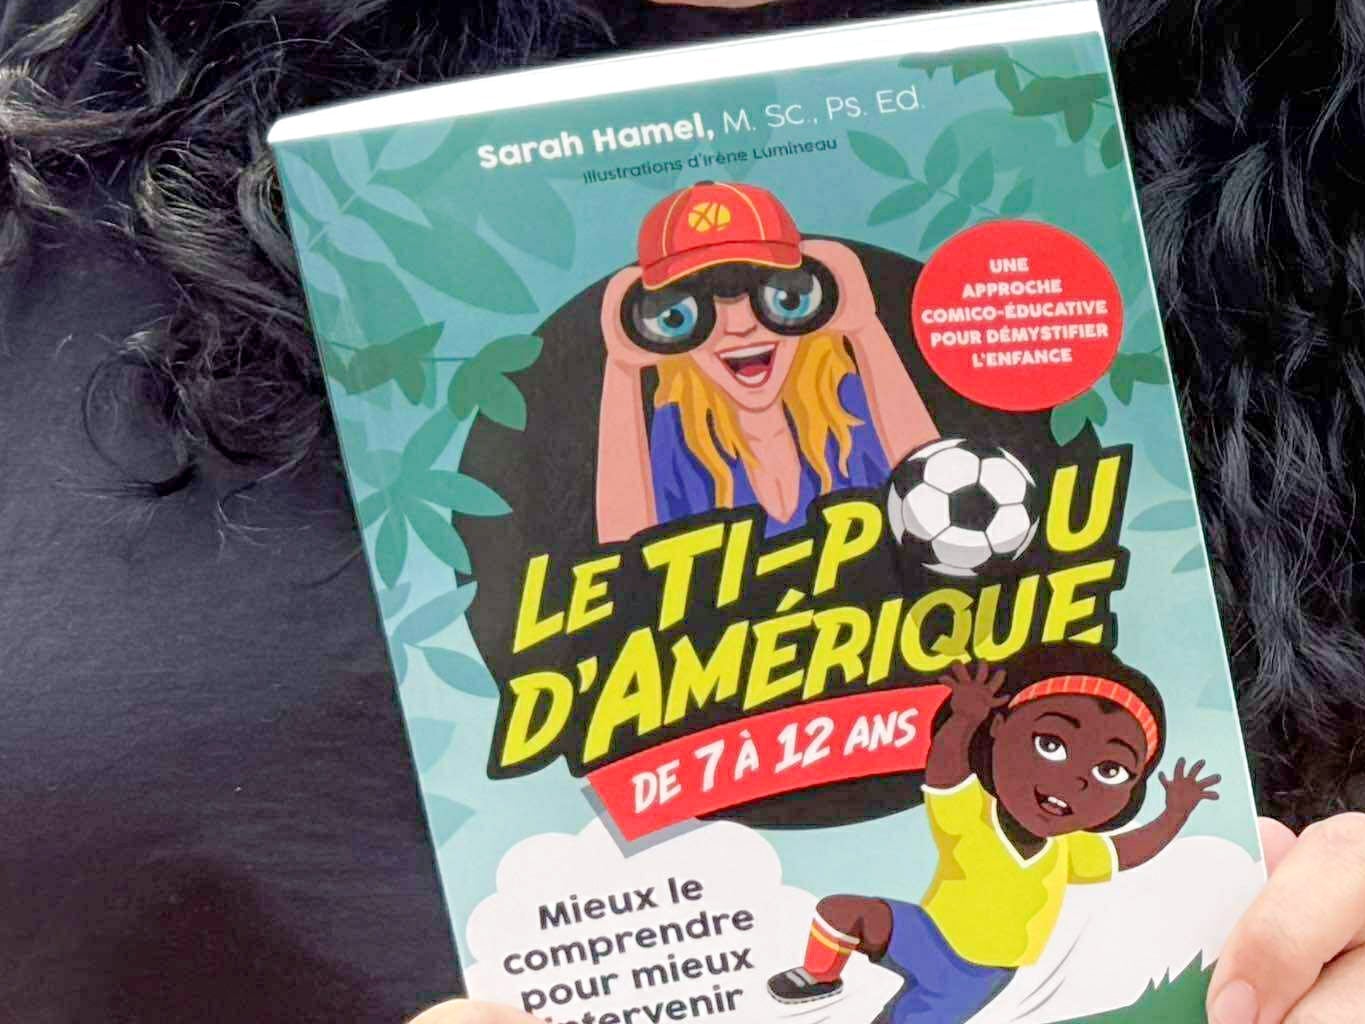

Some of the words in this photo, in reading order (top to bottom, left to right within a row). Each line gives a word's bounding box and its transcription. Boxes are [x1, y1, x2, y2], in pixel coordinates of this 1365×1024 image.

[477, 131, 583, 170] Sarah
[593, 112, 715, 153] Hamel,
[722, 108, 757, 134] M.
[876, 84, 926, 114] Ed.
[583, 158, 683, 184] Illustrations
[753, 138, 838, 160] Lumineau
[962, 278, 1063, 298] APPROCHE
[989, 257, 1029, 273] UNE
[921, 299, 1109, 324] COMICO-ÉDUCATIVE
[931, 329, 982, 347] POUR
[986, 323, 1109, 344] DÉMYSTIFIER
[972, 347, 1072, 368] L'ENFANCE
[513, 552, 620, 655] LE
[499, 558, 1116, 768] D'AMÉRIQUE
[632, 759, 682, 814] DE
[694, 739, 725, 792] 7
[734, 729, 760, 780] À
[774, 716, 835, 773] 12
[843, 708, 919, 756] ANS
[538, 884, 659, 930] Mieux
[667, 876, 704, 905] le
[503, 906, 755, 975] comprendre
[521, 973, 618, 1013] pour
[632, 944, 755, 990] mieux
[541, 984, 744, 1024] tervenir
